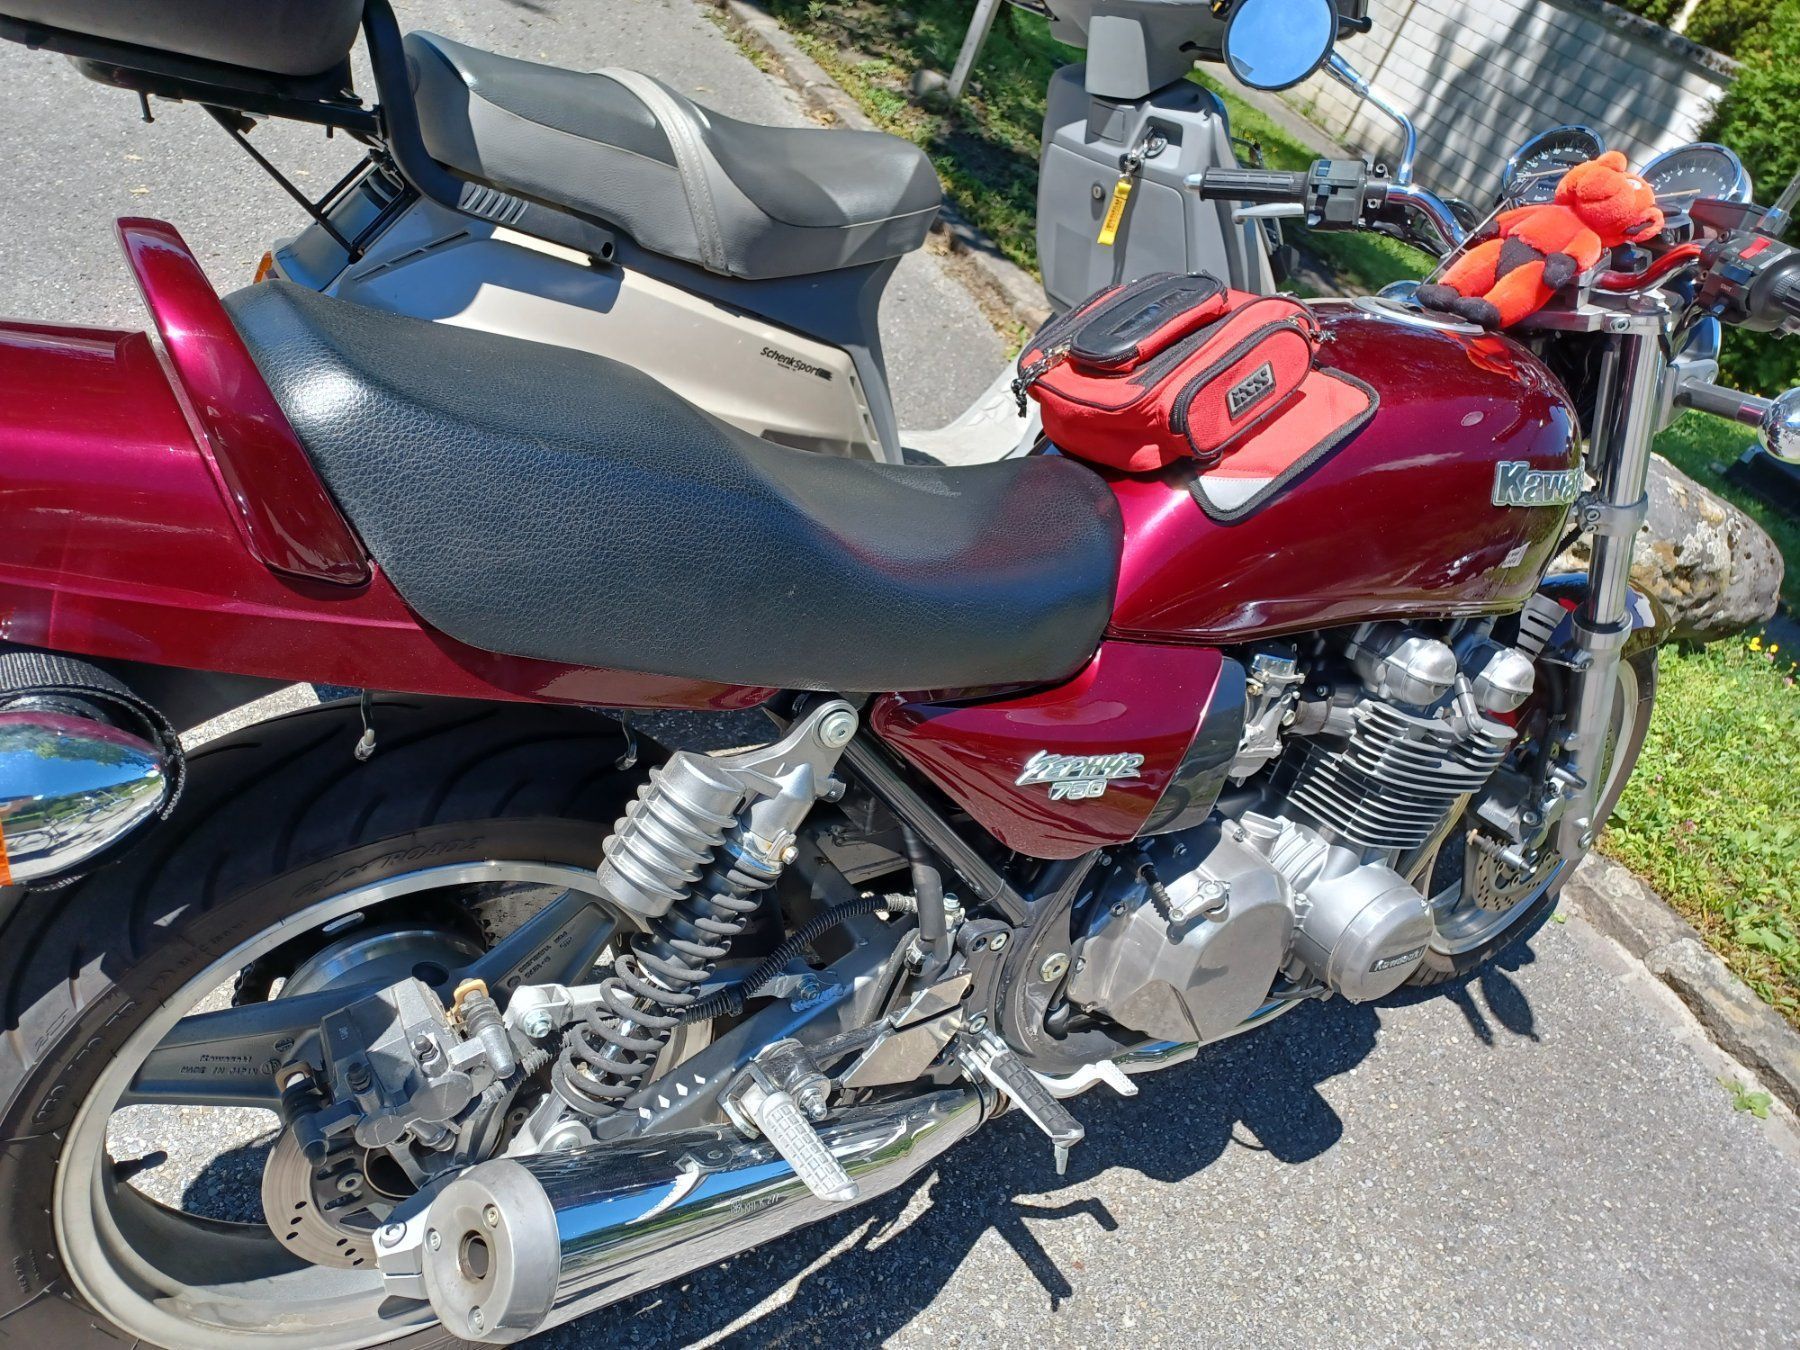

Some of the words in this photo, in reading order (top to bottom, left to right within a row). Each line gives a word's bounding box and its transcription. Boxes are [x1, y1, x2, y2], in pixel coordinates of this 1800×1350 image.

[1492, 460, 1584, 507] Kawa
[1014, 749, 1145, 786] ZEPHYR
[1047, 779, 1108, 801] 750
